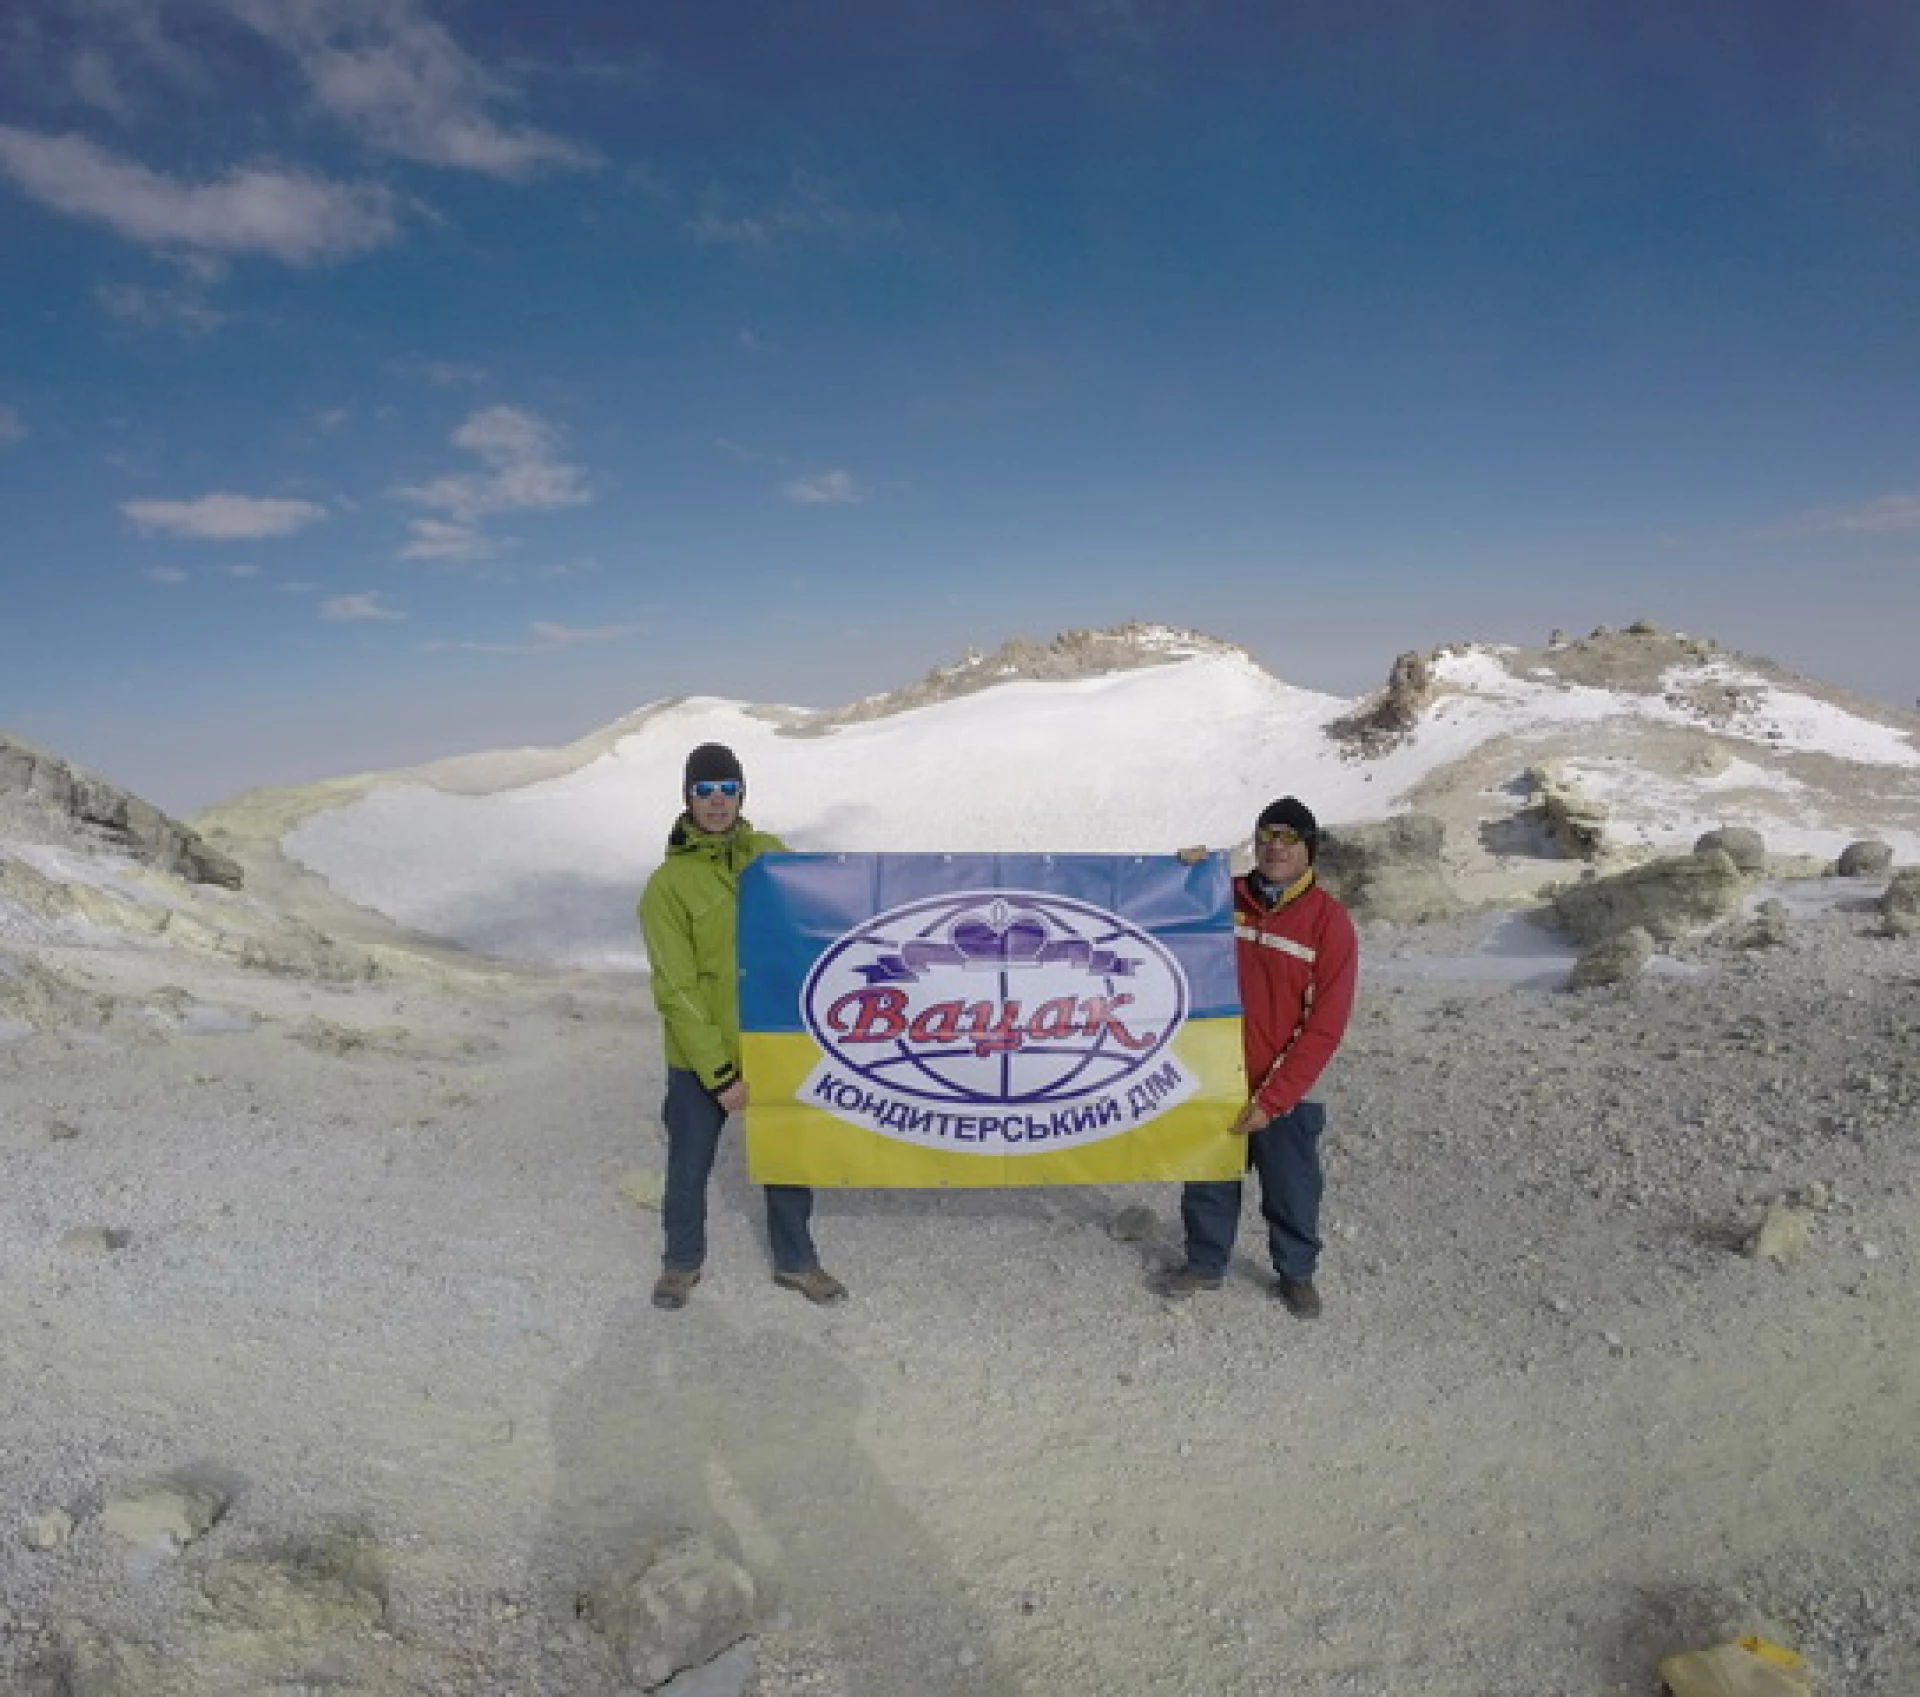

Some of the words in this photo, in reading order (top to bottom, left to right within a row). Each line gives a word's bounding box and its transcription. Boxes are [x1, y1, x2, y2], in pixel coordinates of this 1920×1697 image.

[827, 986, 1157, 1057] Вацак
[814, 1072, 1122, 1142] КОНДИТЕРСЬКИЙ
[1131, 1062, 1182, 1121] ДІМ
